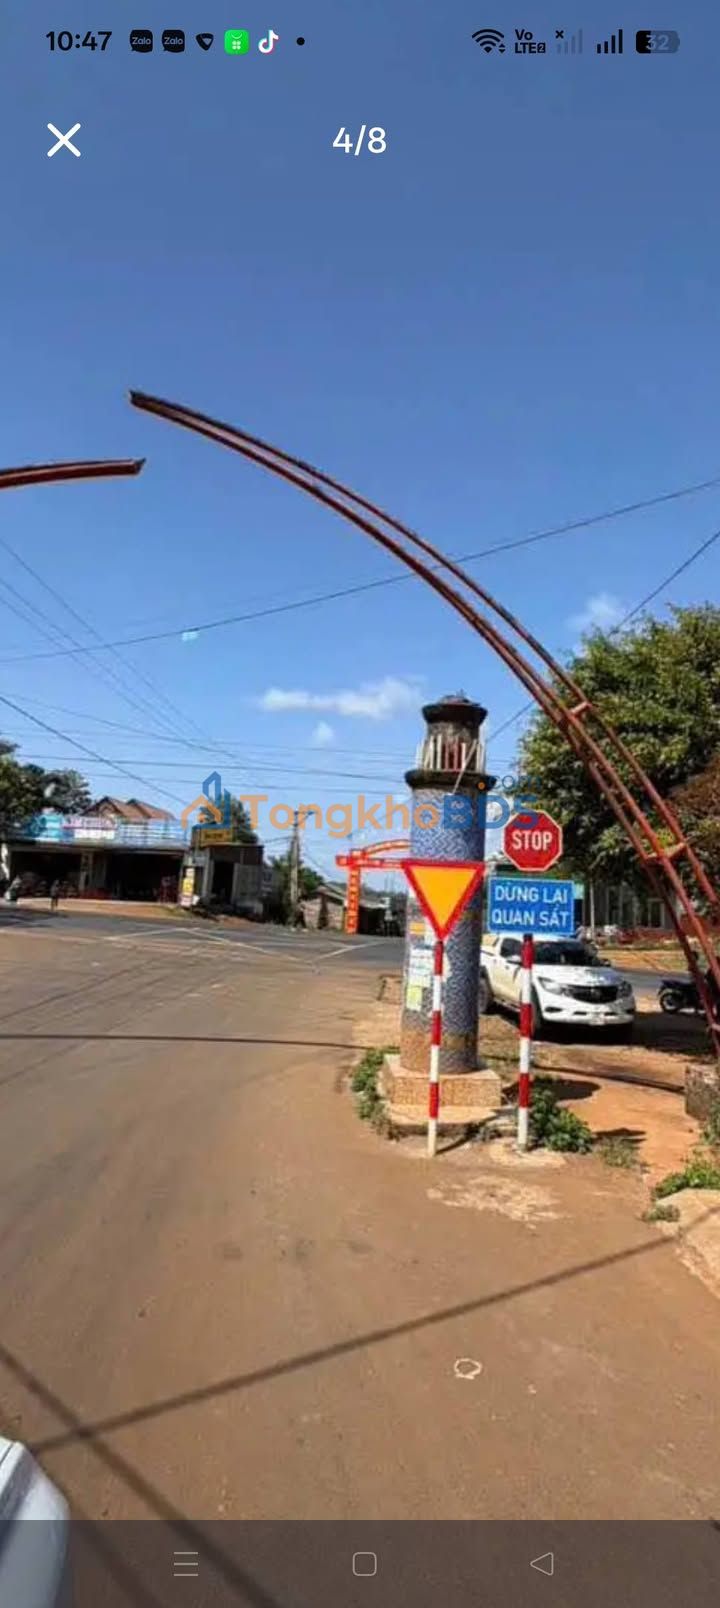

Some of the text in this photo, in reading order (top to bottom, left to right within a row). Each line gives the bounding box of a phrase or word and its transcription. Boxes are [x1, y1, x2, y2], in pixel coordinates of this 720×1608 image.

[511, 831, 553, 852] STOP
[491, 904, 569, 927] QUAN SÁT
